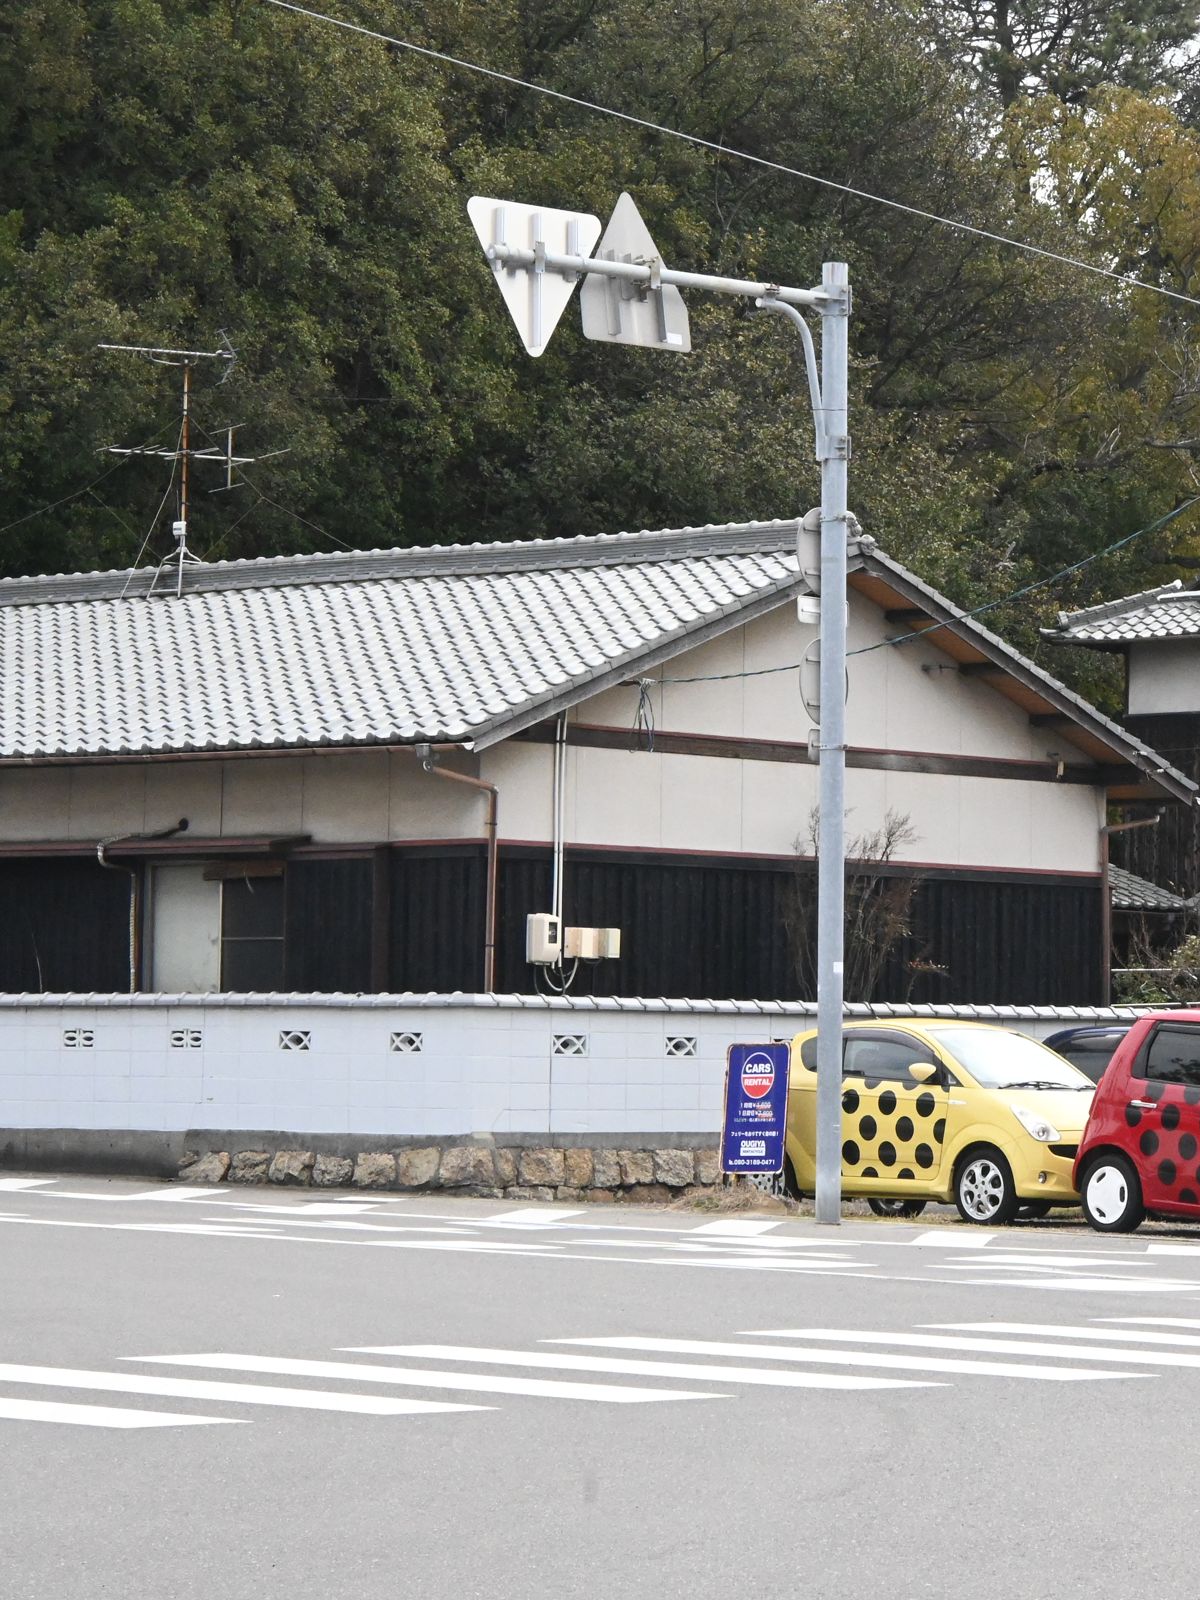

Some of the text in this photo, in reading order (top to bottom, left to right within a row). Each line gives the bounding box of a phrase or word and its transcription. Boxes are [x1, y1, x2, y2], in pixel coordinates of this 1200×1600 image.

[745, 1063, 771, 1073] CARS
[744, 1078, 771, 1086] RENTAL
[740, 1140, 766, 1148] OUGIYA
